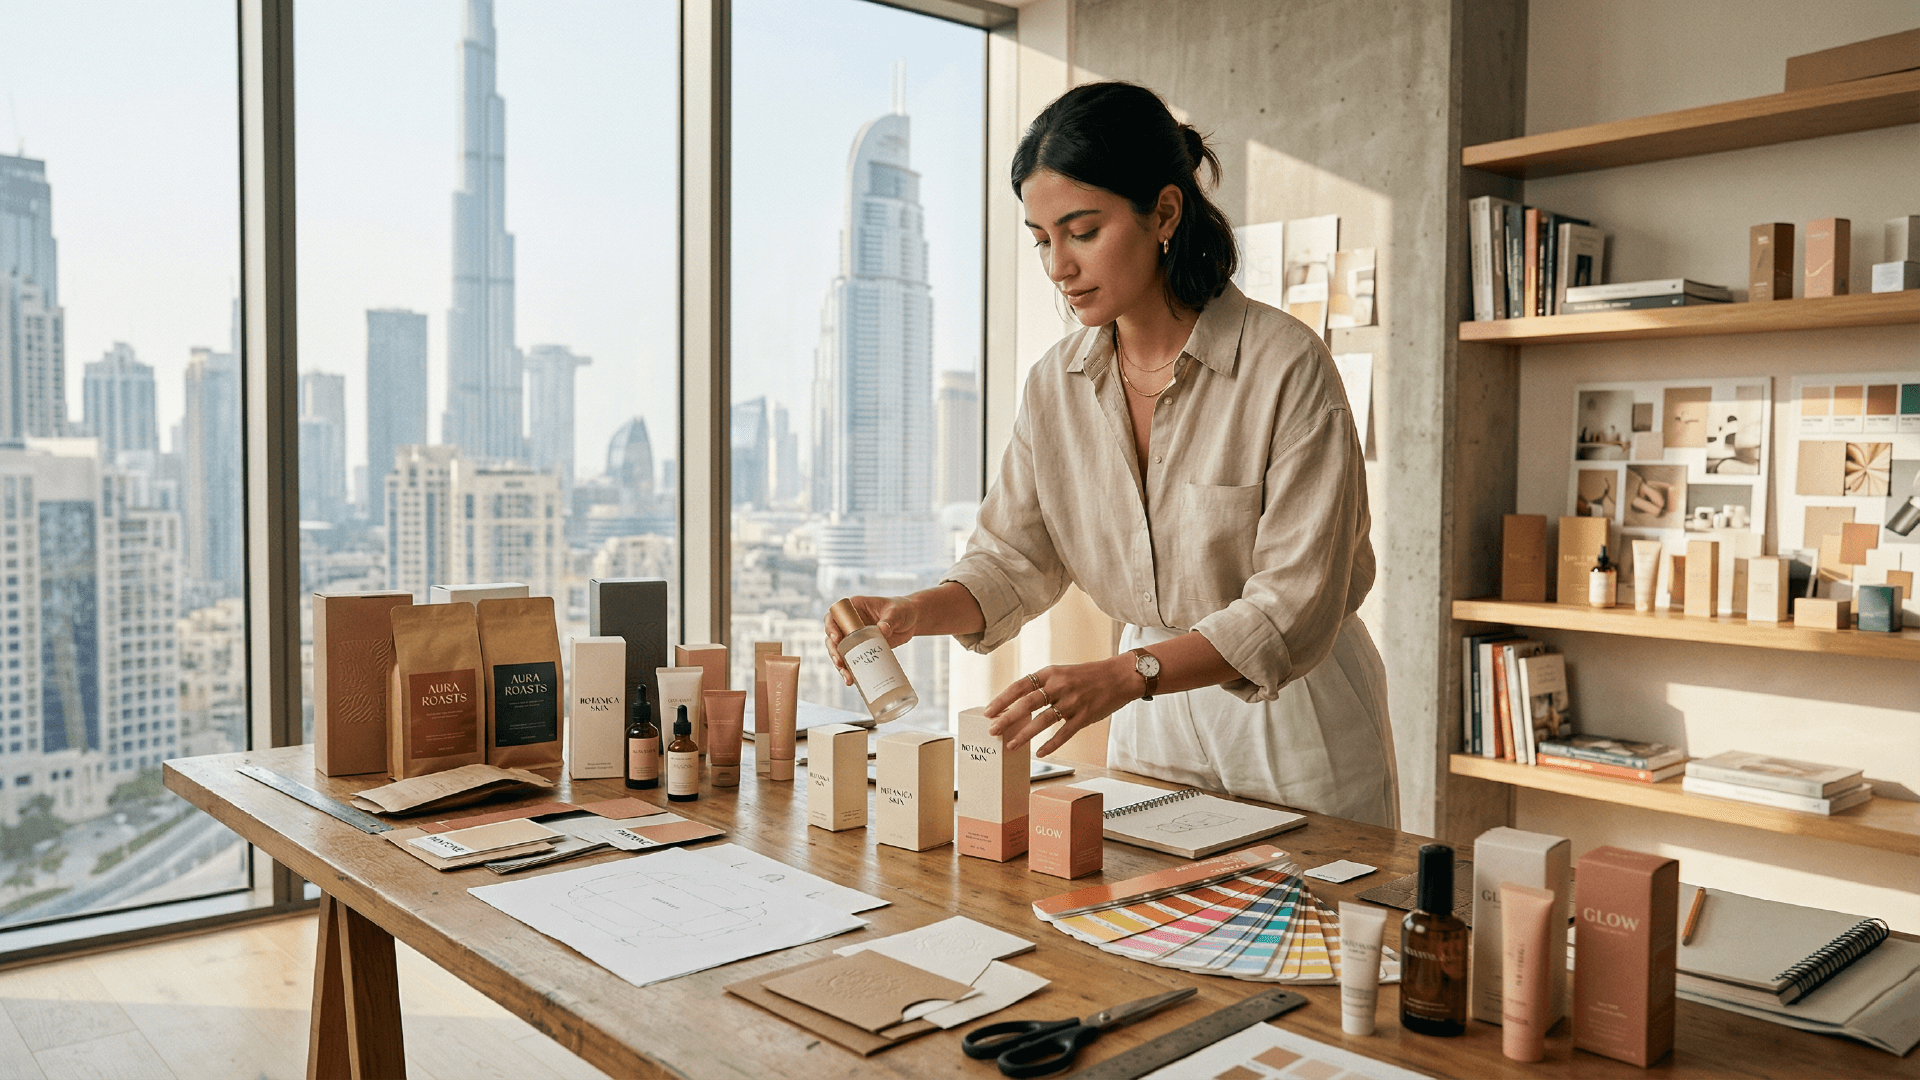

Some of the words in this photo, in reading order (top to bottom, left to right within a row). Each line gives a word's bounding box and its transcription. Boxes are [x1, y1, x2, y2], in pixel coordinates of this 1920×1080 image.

[511, 673, 541, 684] AURA
[428, 682, 460, 694] AURA
[505, 684, 548, 696] ROASTS
[422, 693, 467, 706] ROASTS
[961, 743, 997, 755] BOTANICA
[970, 753, 987, 761] SKIN
[1035, 825, 1063, 839] GLOW
[1583, 907, 1640, 932] GLOW
